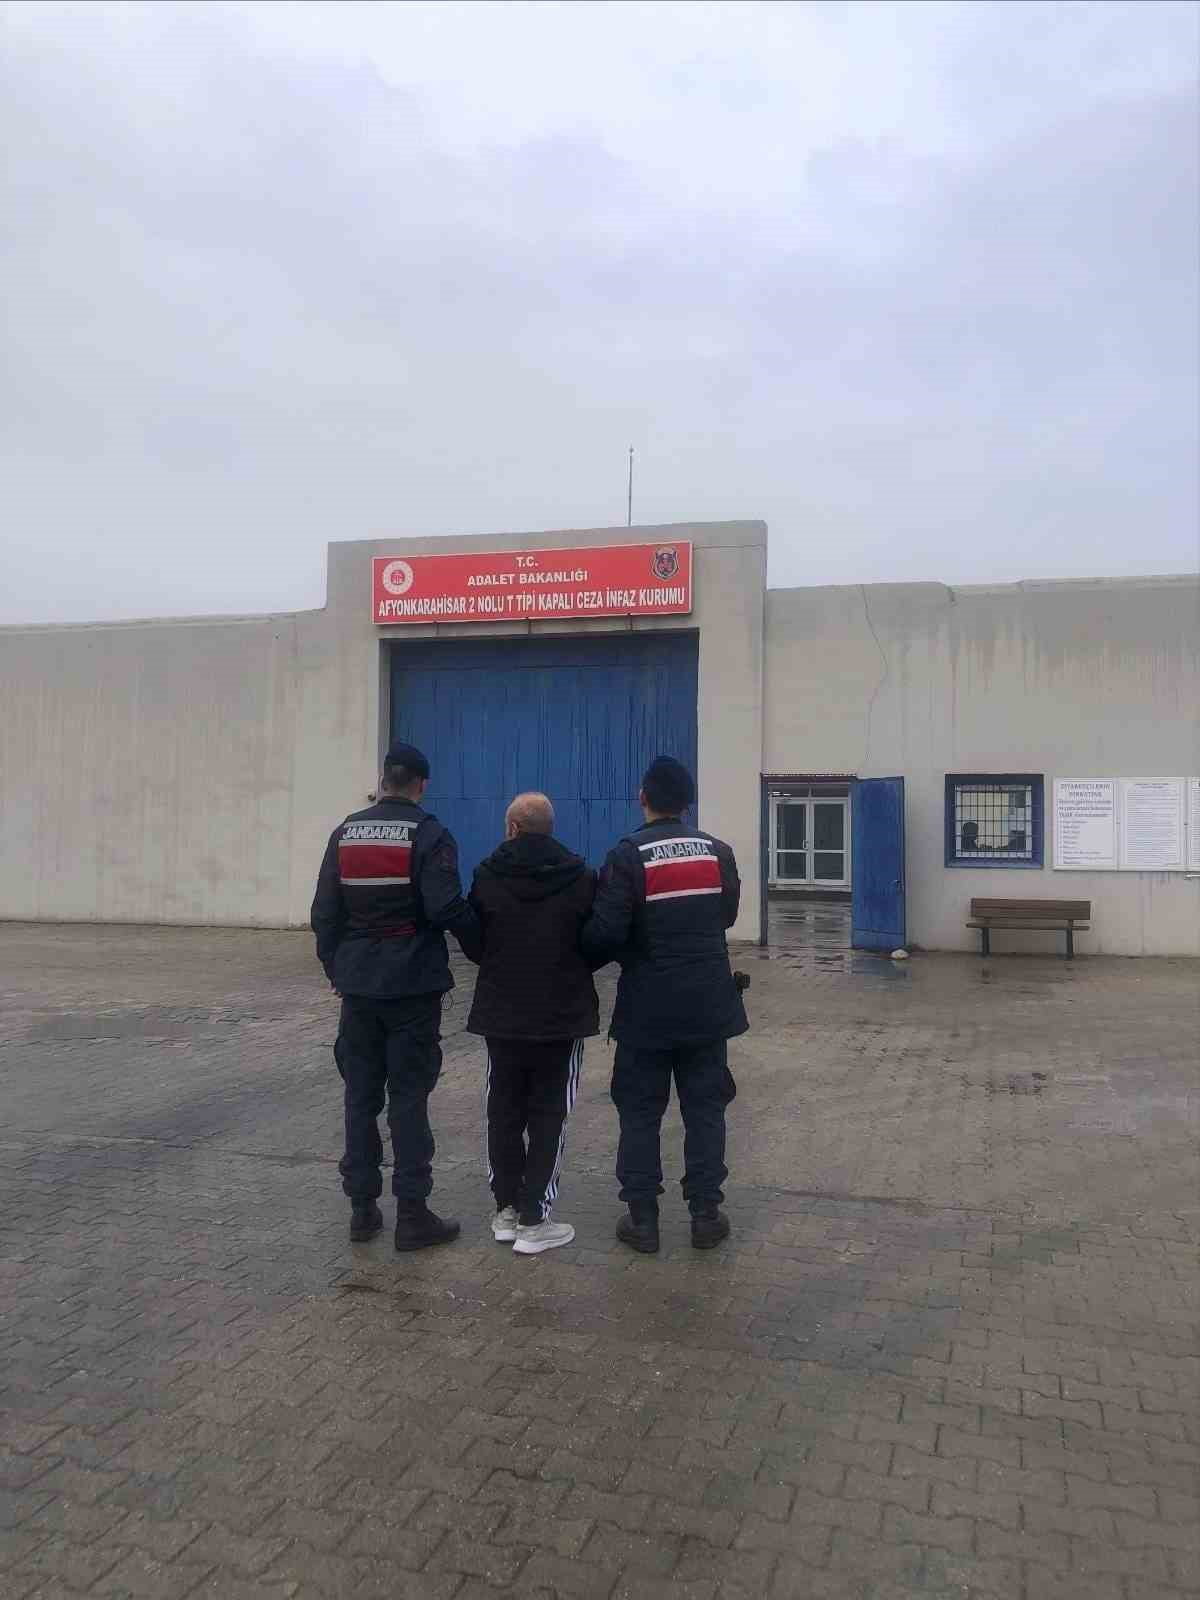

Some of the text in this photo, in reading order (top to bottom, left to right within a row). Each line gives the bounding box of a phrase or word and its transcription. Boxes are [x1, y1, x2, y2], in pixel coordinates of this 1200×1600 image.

[517, 557, 539, 567] T.C.
[468, 568, 588, 586] ADALET BAKANLIĞI
[379, 587, 685, 616] AFYONKARAHİSAR 2 NOLU T TİPİ KAPALI CEZA İNFAZ KURUMU
[343, 826, 409, 840] JANDARMA
[650, 842, 711, 861] JANDARMA
